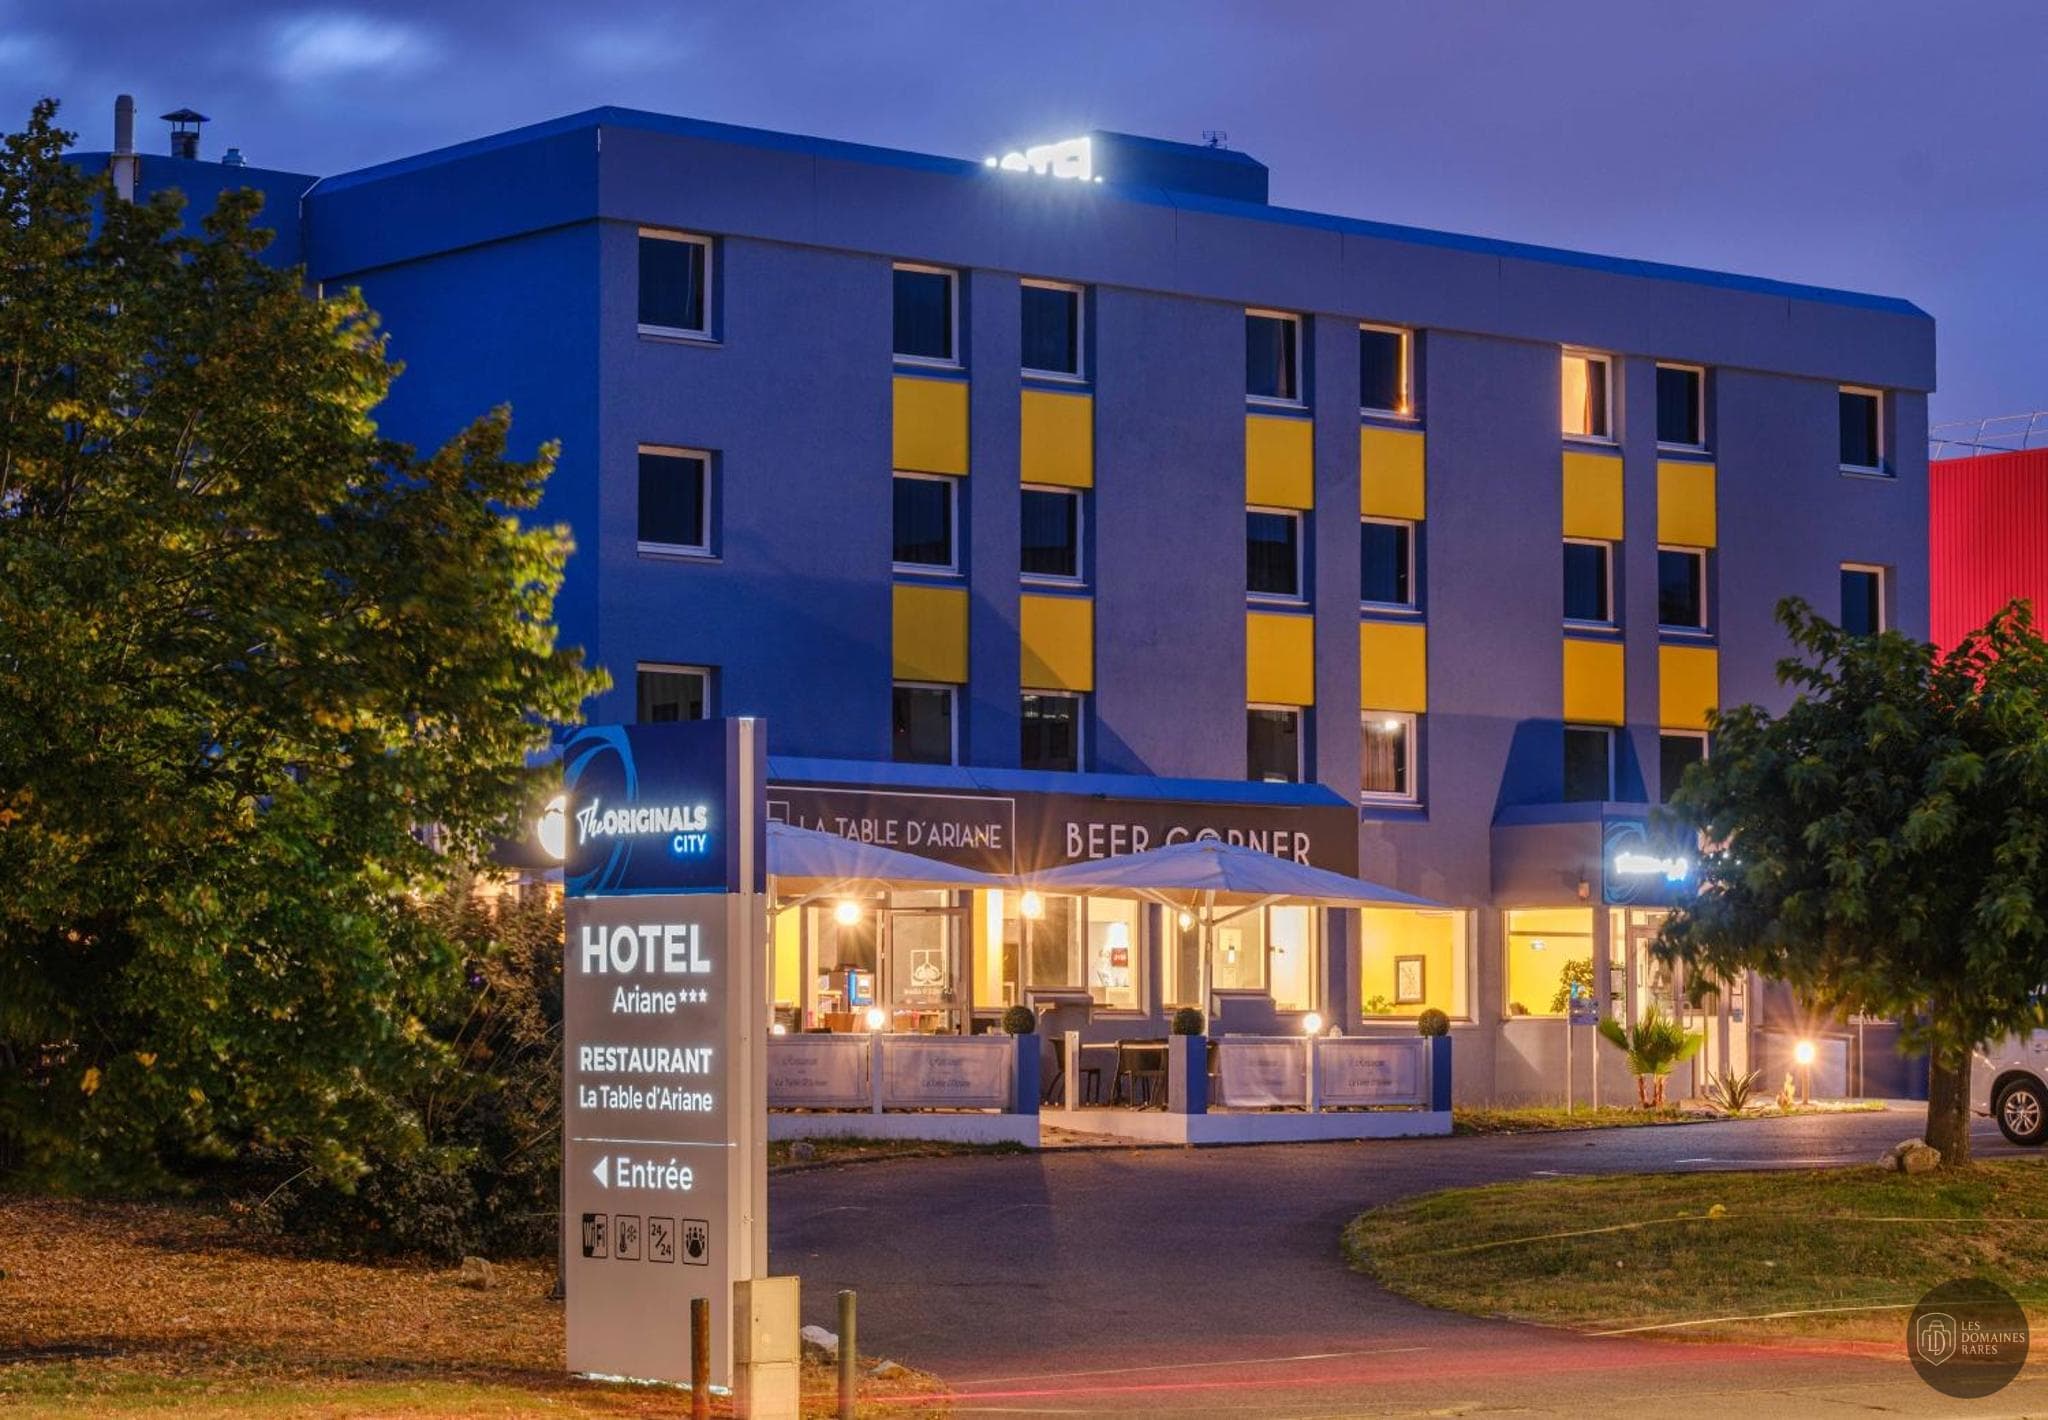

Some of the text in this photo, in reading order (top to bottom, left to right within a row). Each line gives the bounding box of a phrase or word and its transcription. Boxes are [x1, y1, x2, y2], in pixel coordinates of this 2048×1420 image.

[604, 806, 707, 835] ORIGINALS
[834, 816, 898, 844] TABLE
[906, 820, 1002, 849] D'ARIANE
[673, 834, 707, 853] CITY
[1066, 822, 1150, 858] BEER
[581, 924, 711, 973] HOTEL
[580, 1046, 713, 1074] RESTAURANT
[579, 1085, 713, 1112] La Table d'Ariane
[616, 1157, 694, 1190] Entrée
